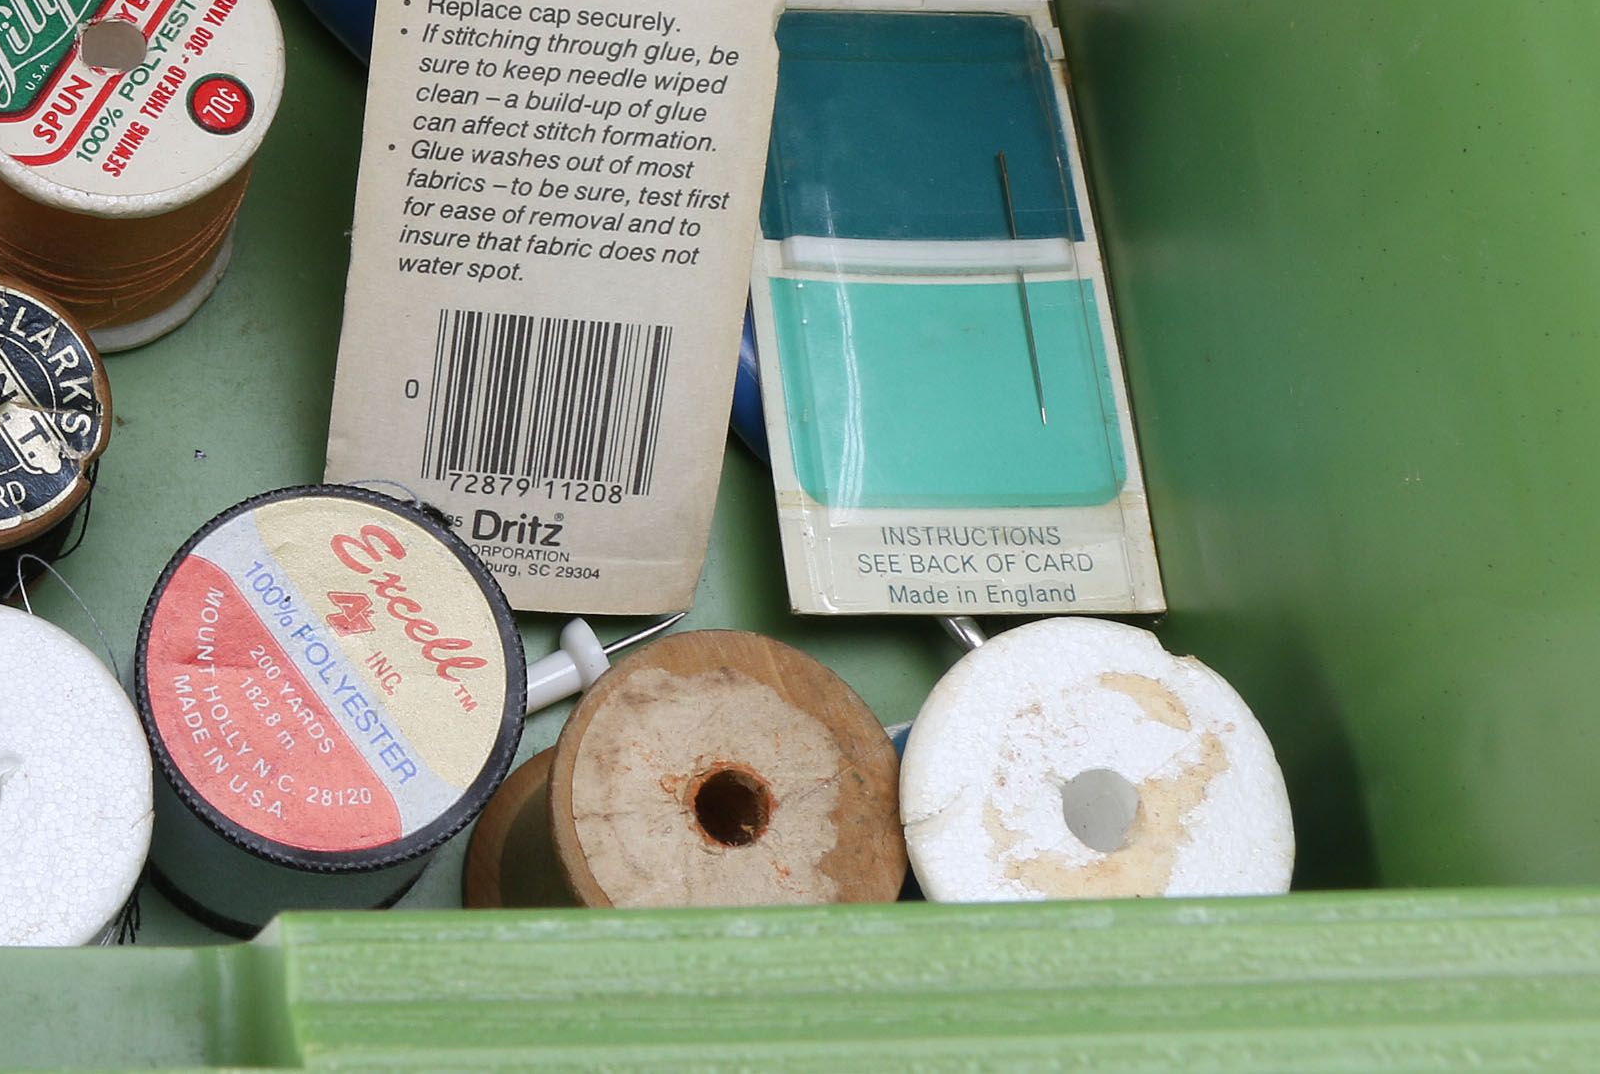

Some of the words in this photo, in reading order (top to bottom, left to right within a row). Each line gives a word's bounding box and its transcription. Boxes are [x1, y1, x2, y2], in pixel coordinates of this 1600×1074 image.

[25, 62, 51, 91] U.S.A.
[33, 74, 93, 144] SPUN
[102, 122, 150, 178] SEWING
[140, 64, 188, 121] THREAD
[184, 27, 215, 58] 300
[76, 107, 124, 163] 100%
[412, 115, 457, 133] can
[461, 114, 530, 139] affect
[532, 121, 597, 144] stitch
[601, 124, 717, 152] formation.
[411, 139, 465, 163] Glue
[471, 147, 561, 170] washes
[566, 154, 605, 173] out
[608, 154, 635, 175] of
[635, 160, 695, 180] most
[405, 167, 486, 193] fabrics
[510, 177, 533, 197] to
[537, 177, 570, 200] be
[573, 185, 631, 207] sure,
[638, 186, 684, 208] test
[685, 188, 731, 210] first
[398, 256, 464, 276] water
[466, 262, 523, 283] spot.
[405, 379, 419, 399] 0
[448, 473, 530, 498] 72879
[545, 480, 623, 505] 11208
[881, 526, 1063, 547] INSTRUCTIONS
[528, 564, 550, 576] SC
[555, 566, 600, 579] 29304
[857, 553, 902, 575] SEE
[911, 553, 978, 574] BACK
[987, 553, 1017, 574] OF
[1024, 552, 1095, 573] CARD
[888, 584, 949, 605] Made
[958, 584, 977, 604] in
[987, 583, 1077, 608] England
[195, 586, 224, 677] MOUNT
[244, 560, 298, 628] 100%
[292, 625, 417, 785] POLYESTER
[203, 686, 253, 755] HOLLY
[238, 676, 281, 726] 182.8
[249, 644, 283, 679] 200
[279, 678, 336, 753] YARDS
[173, 674, 210, 744] MADE
[203, 746, 229, 774] IN
[230, 774, 288, 821] U.S.A.
[306, 786, 372, 805] 28120
